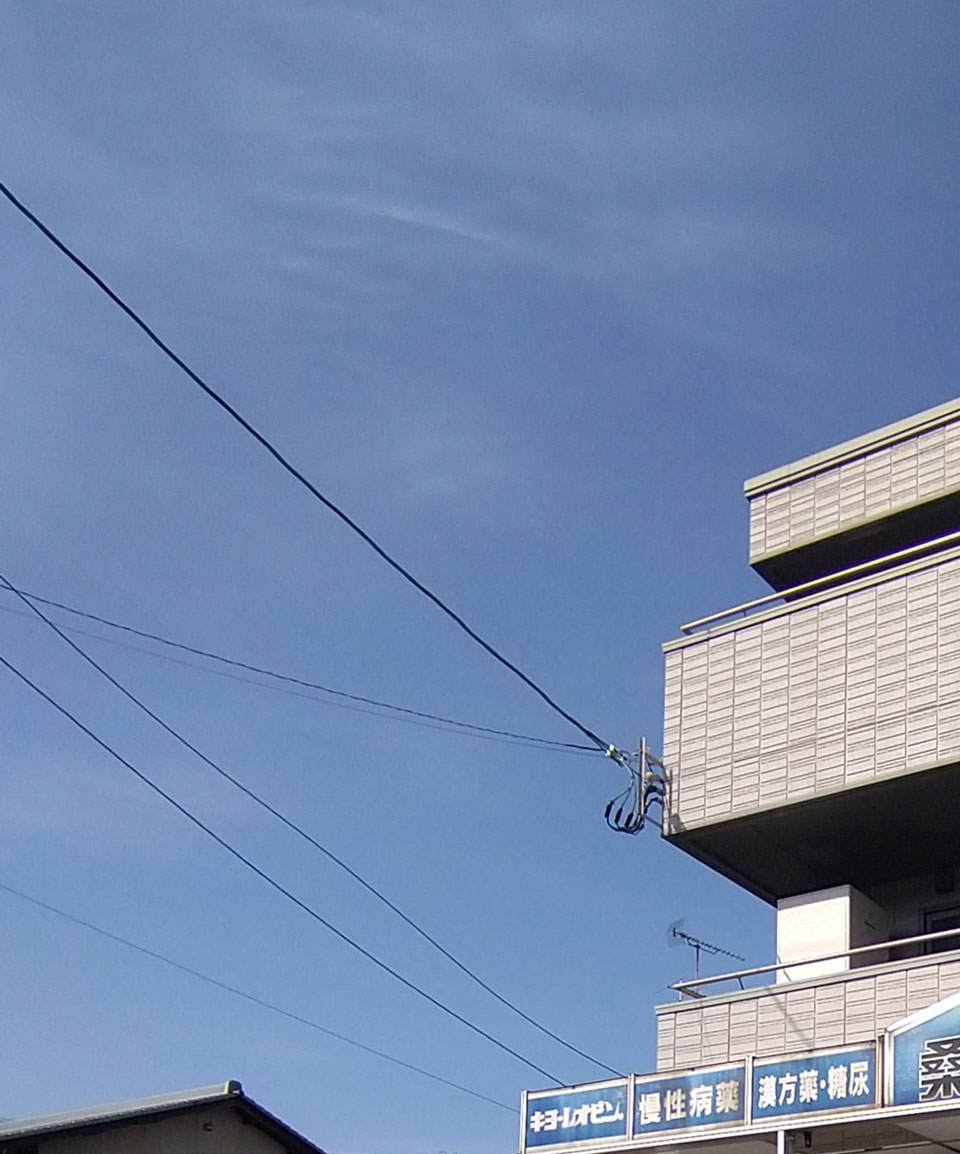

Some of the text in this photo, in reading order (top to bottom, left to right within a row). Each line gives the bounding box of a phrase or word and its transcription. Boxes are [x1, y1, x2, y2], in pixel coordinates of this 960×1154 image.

[639, 1080, 739, 1126] 慢性病薬
[758, 1061, 870, 1109] 漢方薬・糖尿
